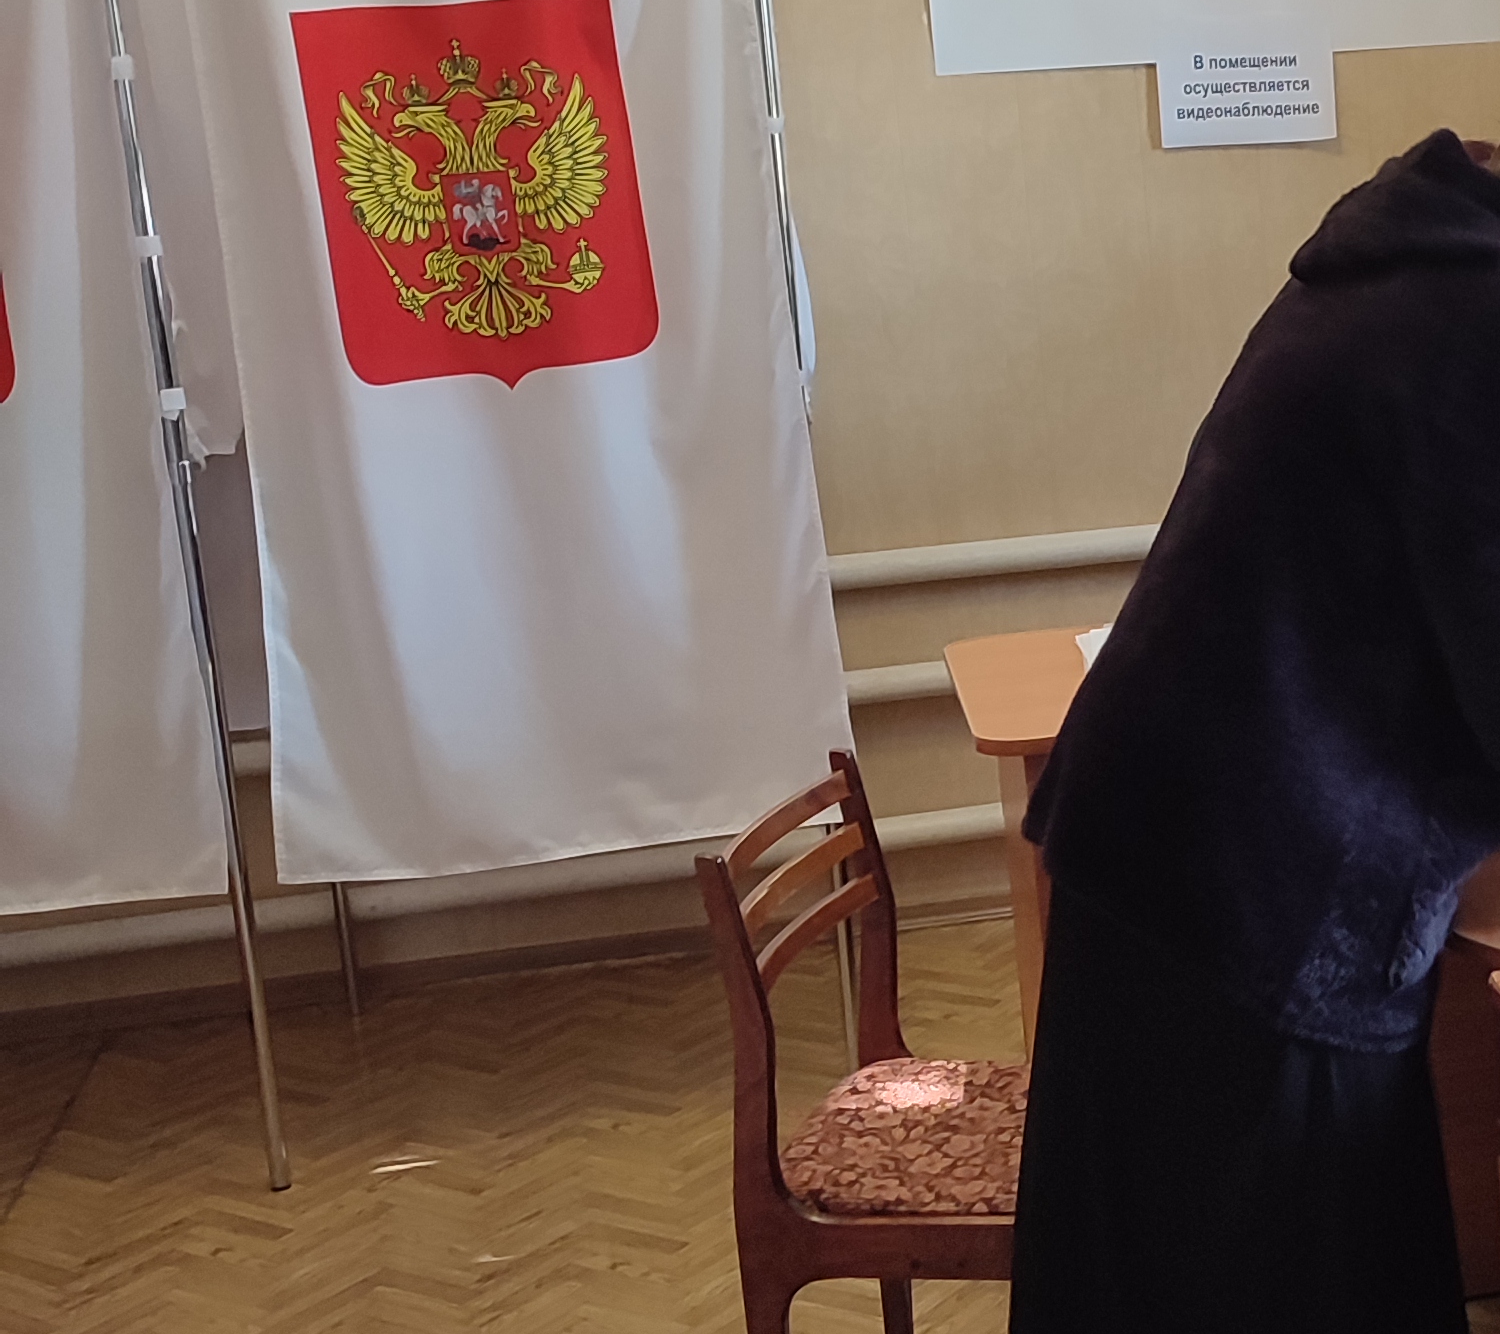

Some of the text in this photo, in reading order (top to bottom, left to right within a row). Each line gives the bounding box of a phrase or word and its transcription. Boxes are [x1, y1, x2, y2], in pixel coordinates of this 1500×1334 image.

[1193, 55, 1297, 70] В помещении
[1183, 79, 1310, 98] осуществляется
[1176, 102, 1320, 121] видеонаблюдение
